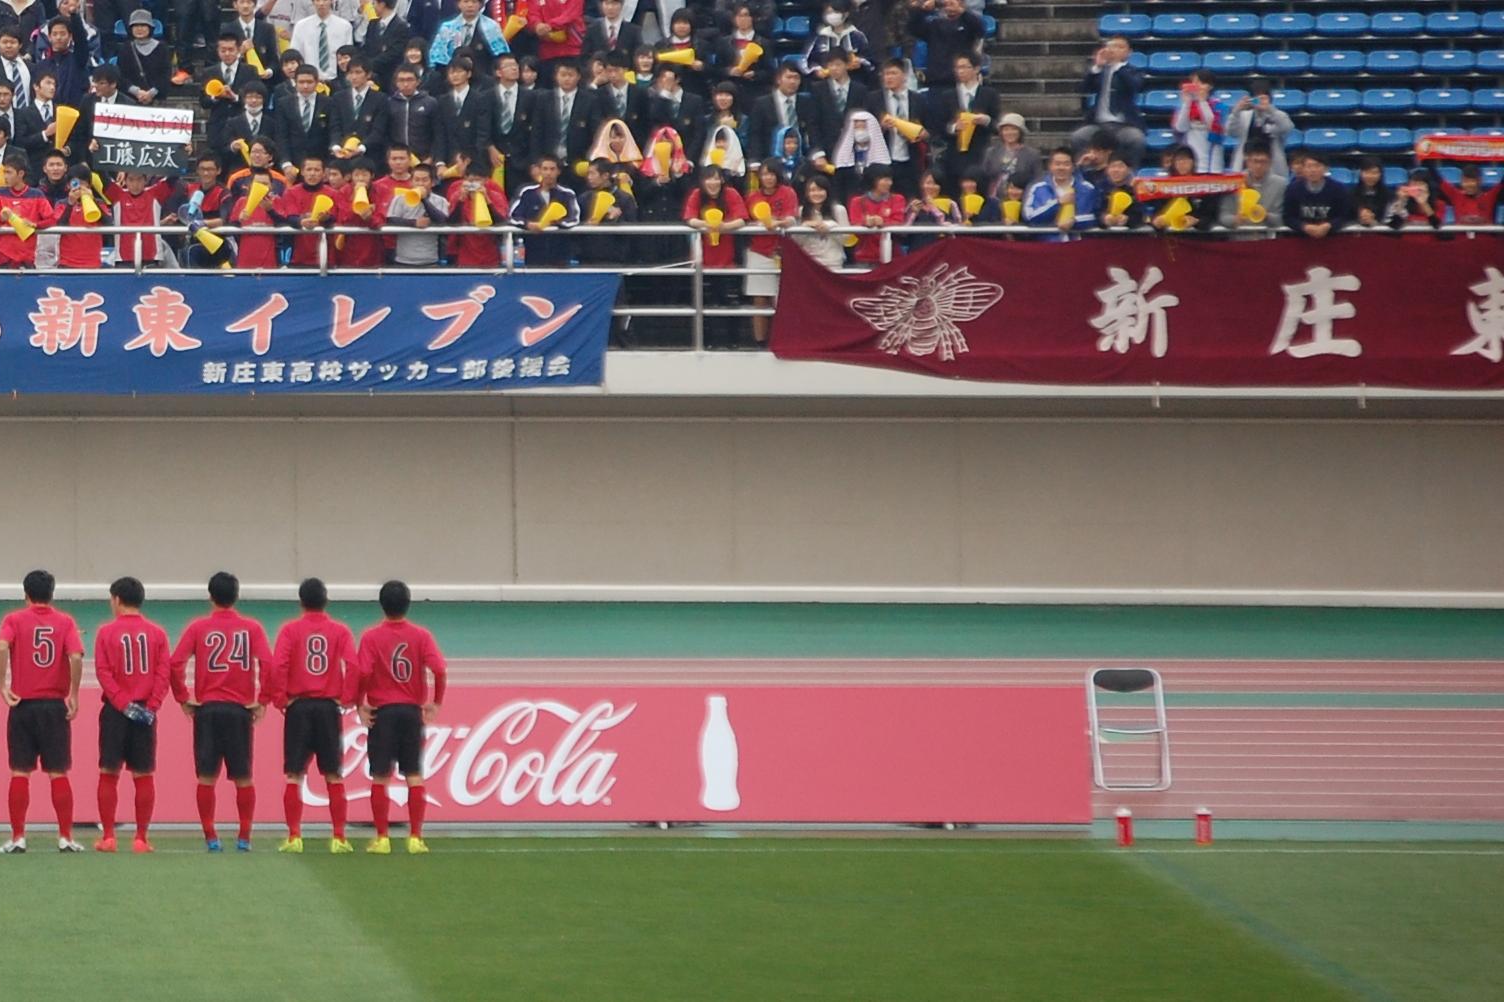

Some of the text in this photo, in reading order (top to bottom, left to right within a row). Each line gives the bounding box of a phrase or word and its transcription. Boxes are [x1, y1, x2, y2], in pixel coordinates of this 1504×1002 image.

[99, 142, 179, 168] 工藤広汰
[1301, 206, 1331, 219] NY
[201, 355, 572, 384] 新庄東高校サッカー部後援会
[32, 626, 55, 668] 5
[121, 633, 149, 674] 11
[206, 631, 250, 672] 24
[306, 634, 328, 675] 8
[392, 643, 413, 683] 6
